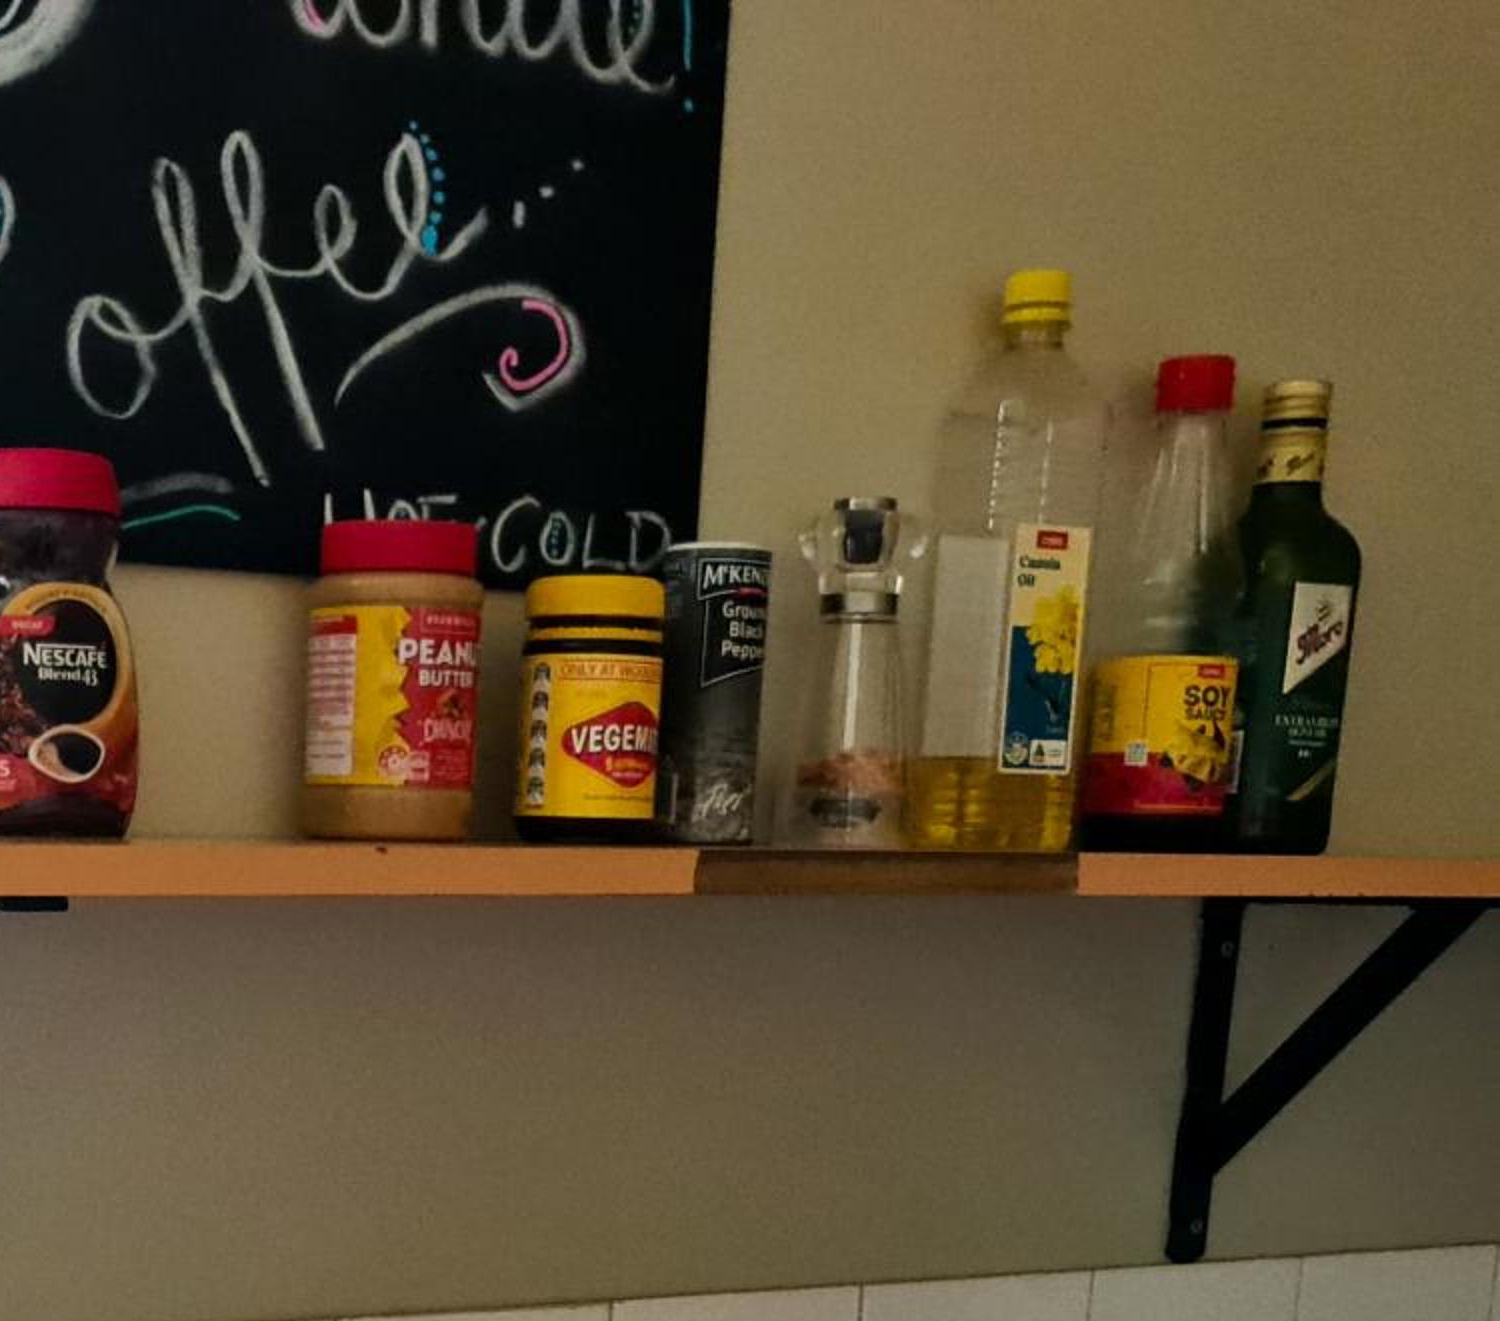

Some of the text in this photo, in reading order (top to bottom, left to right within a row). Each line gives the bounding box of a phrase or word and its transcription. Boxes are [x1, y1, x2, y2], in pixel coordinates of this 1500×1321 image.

[491, 494, 673, 573] COLD
[1184, 684, 1231, 707] SOY
[571, 722, 659, 754] VEGEM
